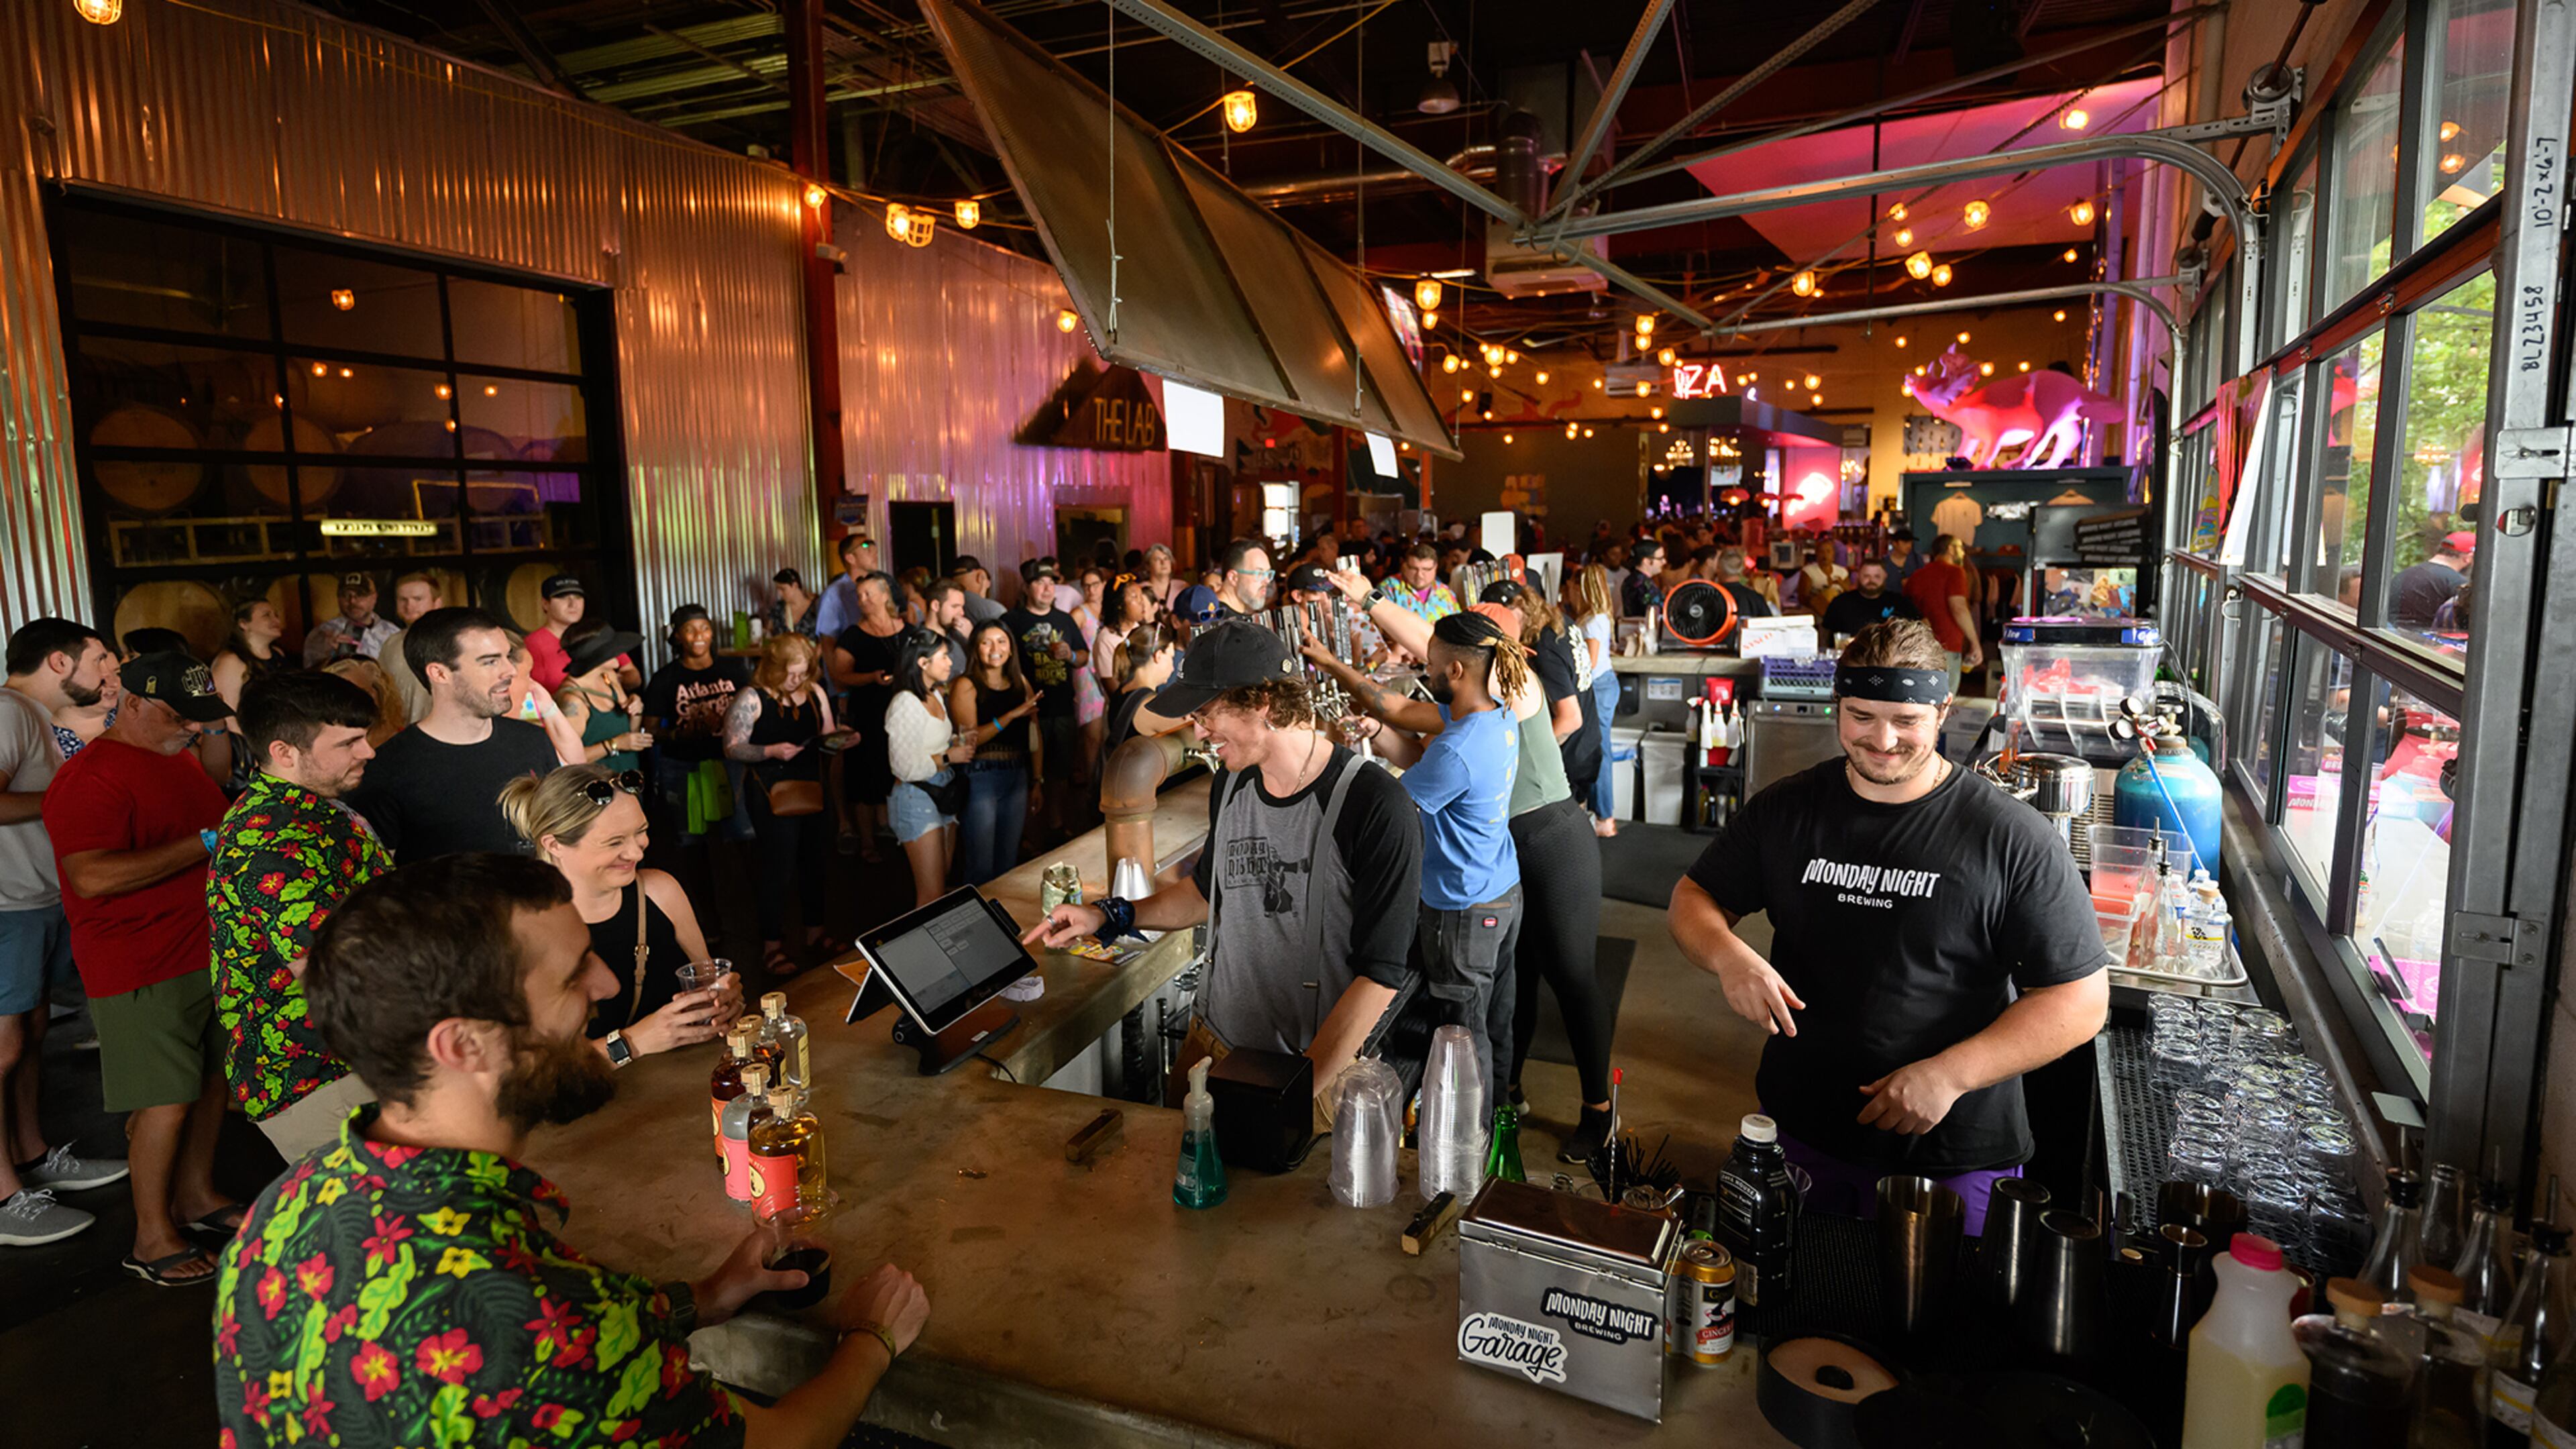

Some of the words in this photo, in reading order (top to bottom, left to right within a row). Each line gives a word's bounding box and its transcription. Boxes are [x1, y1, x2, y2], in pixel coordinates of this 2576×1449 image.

[1093, 397, 1124, 442] THE
[1125, 400, 1155, 446] LAB
[676, 678, 736, 702] Atlanta
[1801, 857, 1882, 895] MONDAY
[1879, 868, 1941, 898] NIGHT
[1837, 893, 1894, 910] BREWING
[1487, 1316, 1526, 1339] MONDAY
[1527, 1328, 1554, 1345] NIGHT
[1546, 1291, 1608, 1326] MONDAY
[1609, 1308, 1654, 1337] NIGHT
[1574, 1321, 1623, 1341] BREWING
[1462, 1317, 1563, 1377] Garage
